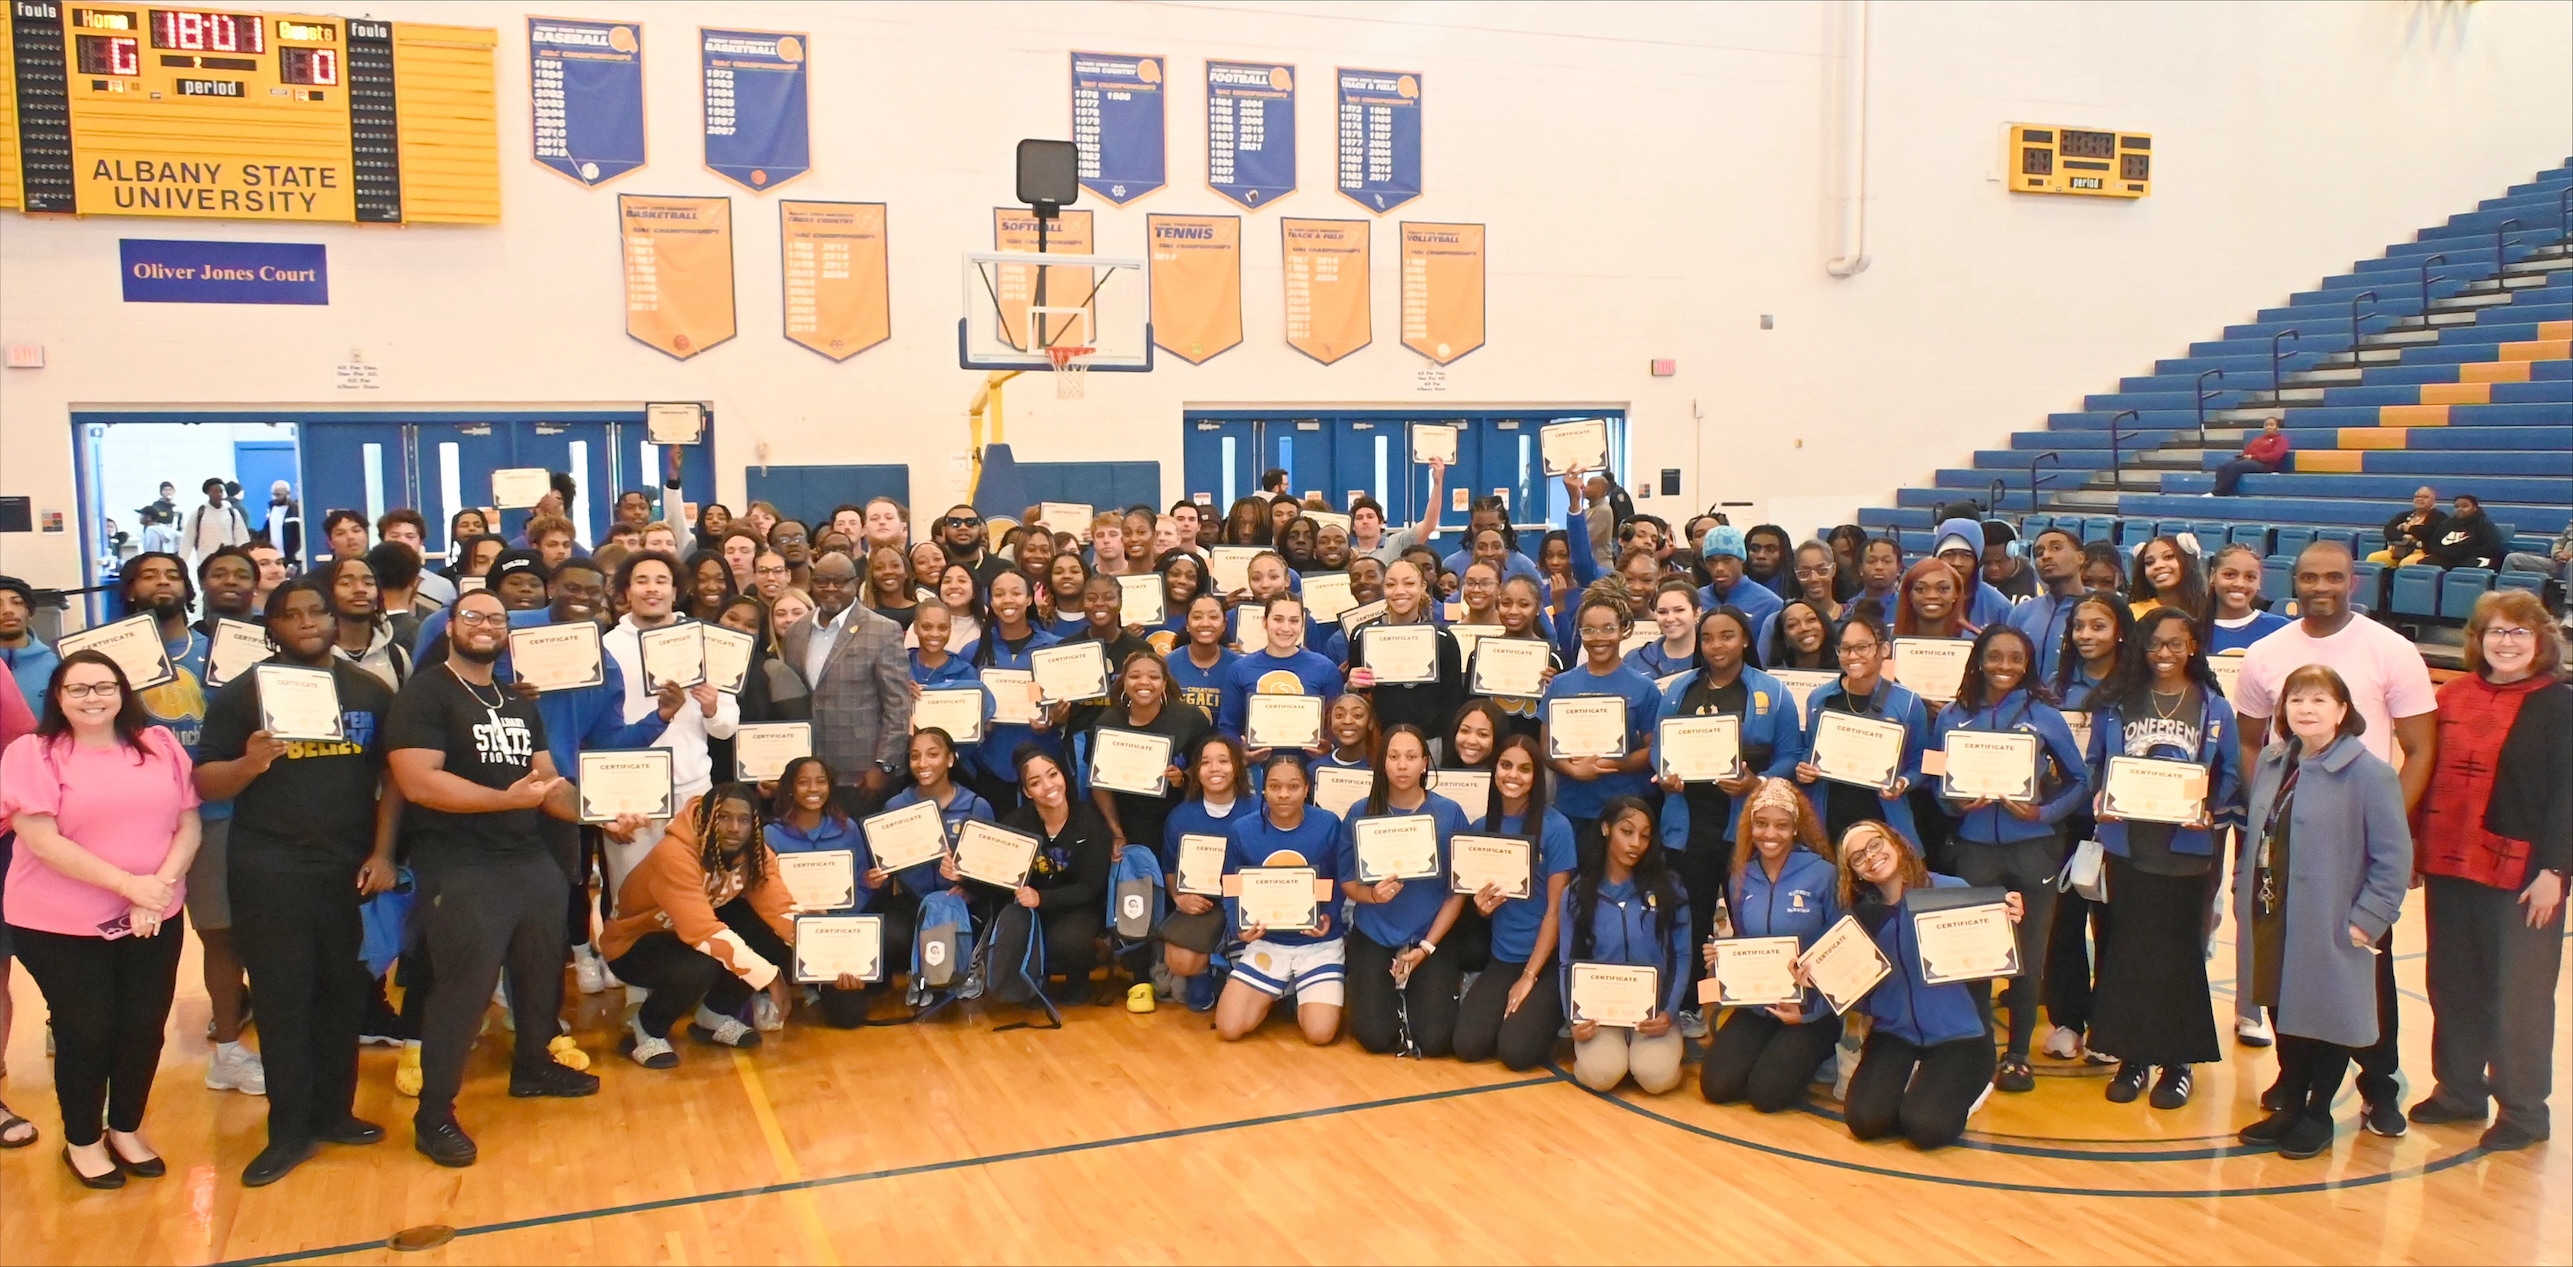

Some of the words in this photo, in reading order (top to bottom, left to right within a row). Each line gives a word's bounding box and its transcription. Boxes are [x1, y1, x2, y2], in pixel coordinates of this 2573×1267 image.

[17, 2, 56, 19] fouls
[82, 10, 129, 30] Home
[279, 22, 333, 42] Guests
[351, 23, 387, 40] fouls
[533, 31, 609, 46] BASEBALL
[705, 43, 777, 55] BASKETBALL
[312, 50, 336, 85] 0
[1102, 68, 1136, 76] COUNTRY
[1210, 73, 1268, 85] FOOTBALL
[185, 79, 236, 97] period
[1342, 82, 1367, 90] TRACK
[1075, 99, 1099, 107] 1977
[1240, 125, 1263, 133] 2010
[1341, 138, 1362, 146] 1977
[92, 159, 222, 185] ALBANY
[242, 164, 338, 189] STATE
[1369, 174, 1392, 182] 2017
[2073, 177, 2099, 189] period
[113, 186, 318, 213] UNIVERSITY
[626, 210, 698, 220] BASKETBALL
[1156, 227, 1213, 239] TENNIS
[1407, 235, 1459, 243] VOLLEYBALL
[133, 263, 196, 280] Oliver
[201, 264, 255, 281] Jones
[259, 266, 316, 282] Court
[1554, 430, 1590, 440] CERTIFICATE
[1356, 610, 1386, 623] CERTIFICA
[234, 633, 266, 645] CERTIFIC
[529, 634, 578, 645] CERTIFICATE
[659, 634, 692, 646] CERTIFICATE
[1047, 653, 1086, 663] CERTIFICATE
[1493, 648, 1532, 656] CERTIFICATE
[277, 680, 318, 689] CERTIFICATE
[472, 709, 532, 756] STATE
[1837, 725, 1883, 738] CERTIFICATE
[2123, 718, 2200, 749] ONFERENC
[1112, 741, 1152, 751] CERTIFICATE
[1965, 743, 2015, 751] CERTIFICATE
[2130, 769, 2183, 778] CERTIFICATE
[881, 814, 922, 830] CERTIFICATE
[1373, 826, 1417, 834] CERTIFICATE
[978, 833, 1020, 849] CERTIFICATE
[1468, 846, 1512, 854] CERTIFICATE
[793, 860, 836, 868] CERTIFICATE
[1936, 918, 1989, 930] CERTIFICATE
[1815, 934, 1847, 965] CERTIFICATE
[1590, 975, 1638, 983] CERTIFICATE
